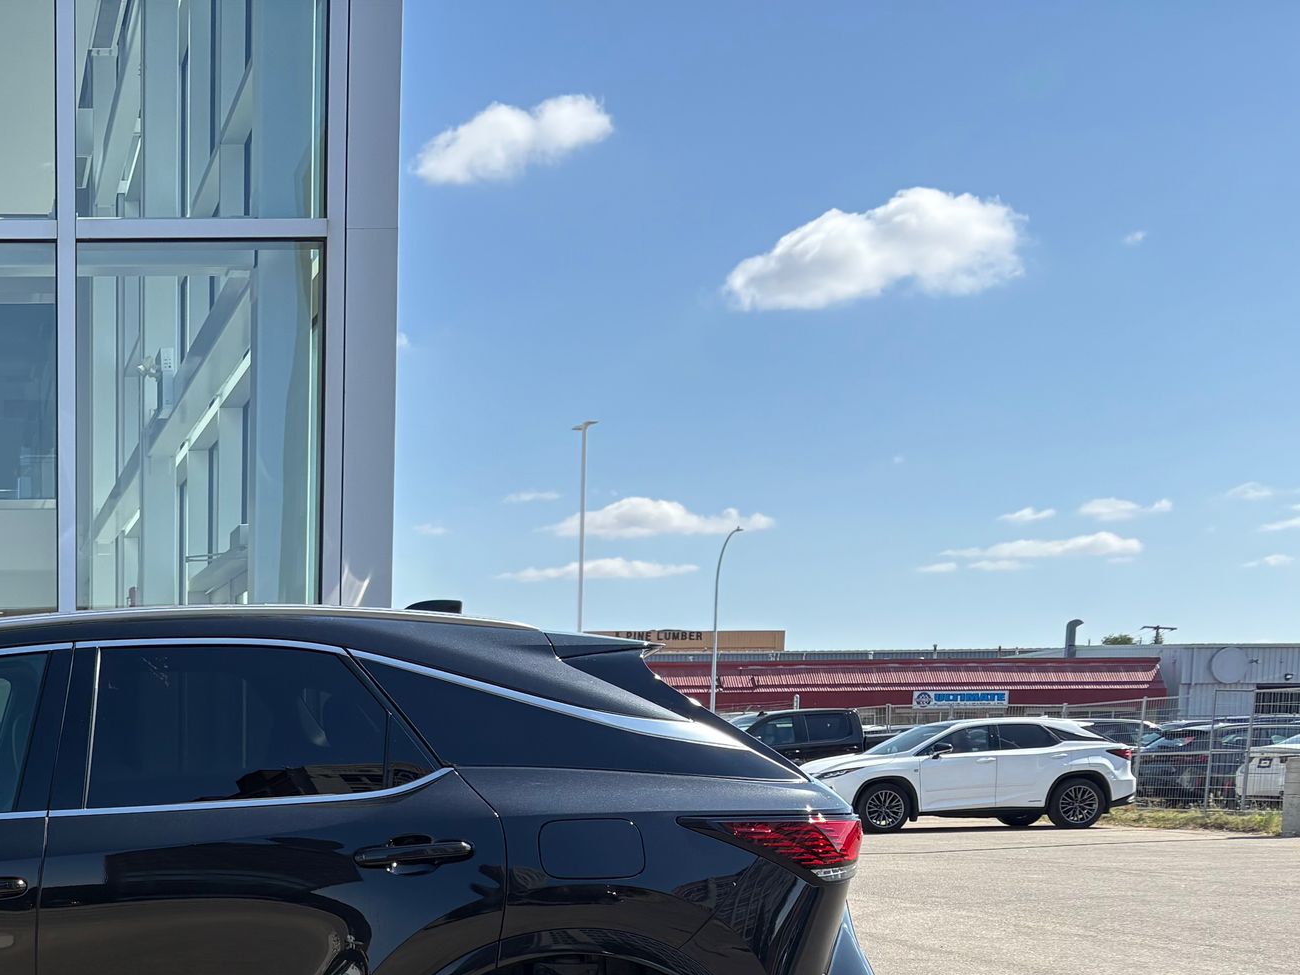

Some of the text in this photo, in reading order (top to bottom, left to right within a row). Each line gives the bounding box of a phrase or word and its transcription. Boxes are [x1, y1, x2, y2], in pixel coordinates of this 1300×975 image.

[626, 632, 652, 641] PINE
[657, 632, 703, 641] LUMBER
[934, 693, 1006, 702] ULTIMATE
